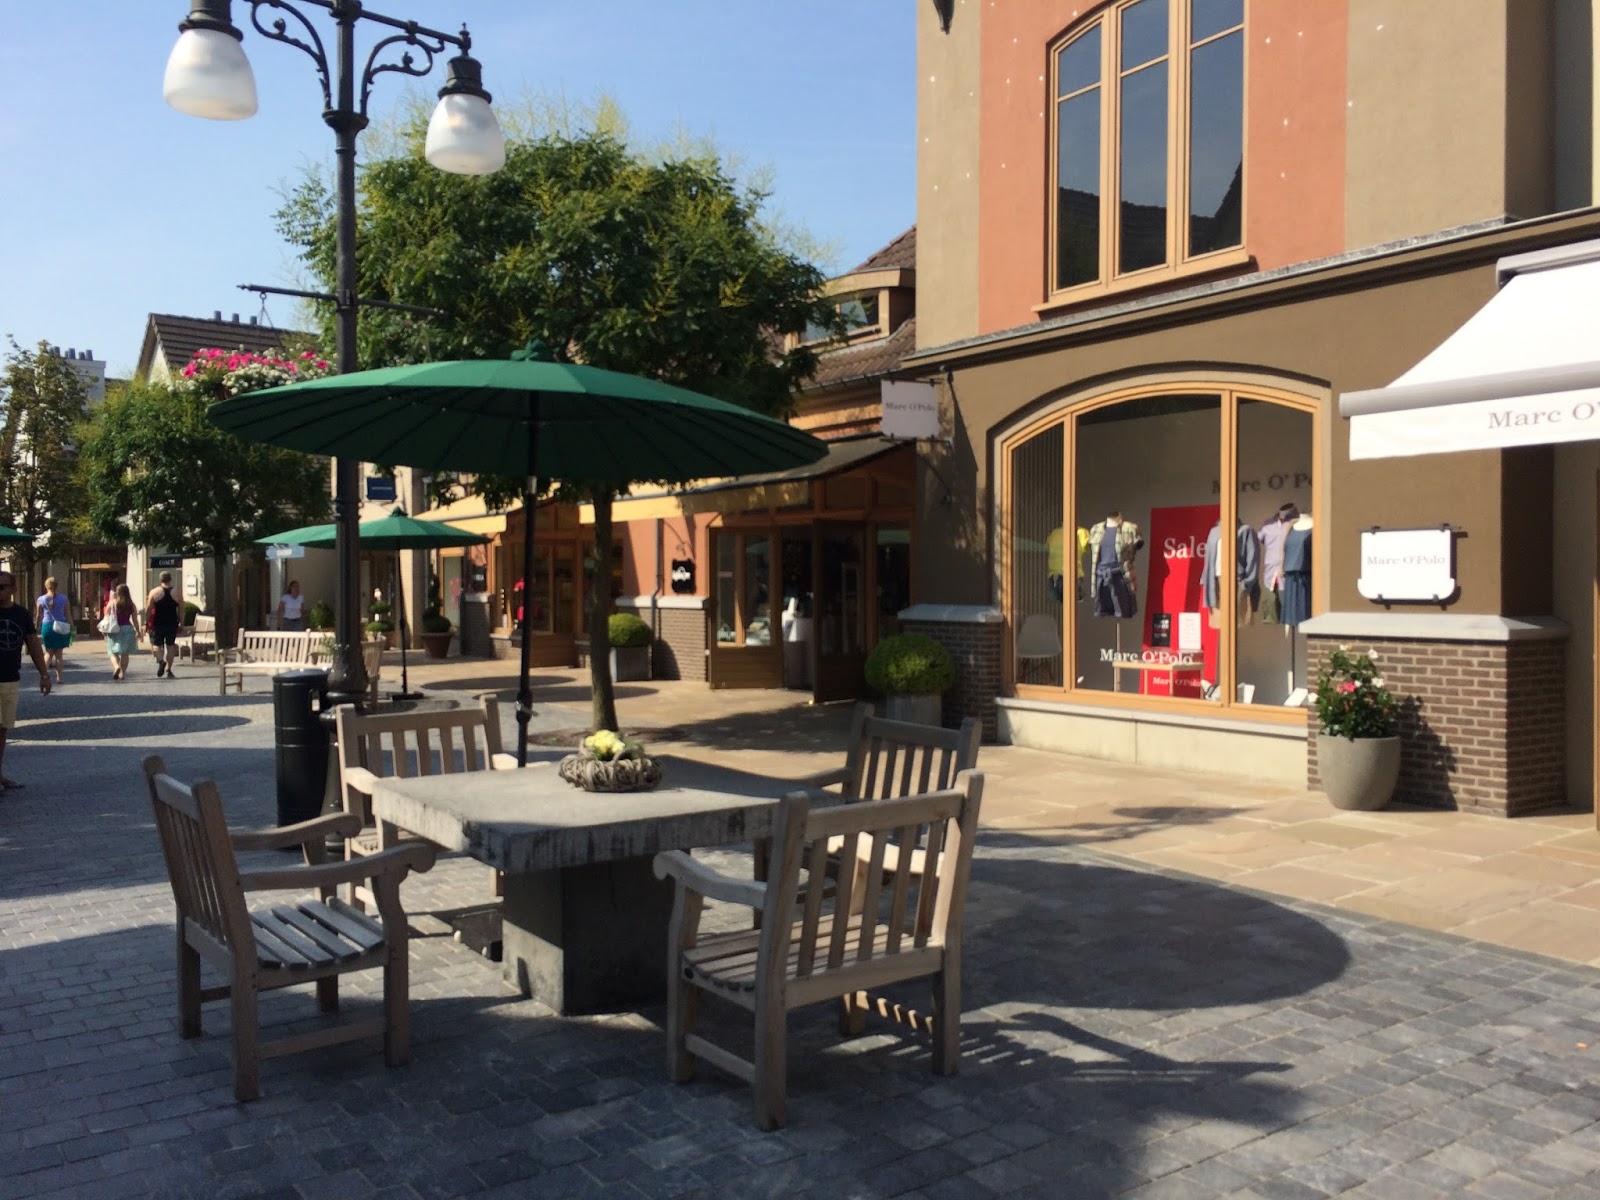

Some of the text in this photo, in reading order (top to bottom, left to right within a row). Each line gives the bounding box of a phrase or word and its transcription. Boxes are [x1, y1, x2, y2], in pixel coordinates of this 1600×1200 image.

[886, 402, 907, 411] Marc
[1488, 410, 1561, 429] Marc
[1211, 479, 1261, 495] Mrc
[1163, 535, 1208, 559] Sale
[1367, 554, 1446, 566] Marc O'Polo
[1100, 648, 1194, 665] Marc O'Polo
[1152, 676, 1171, 686] Mar
